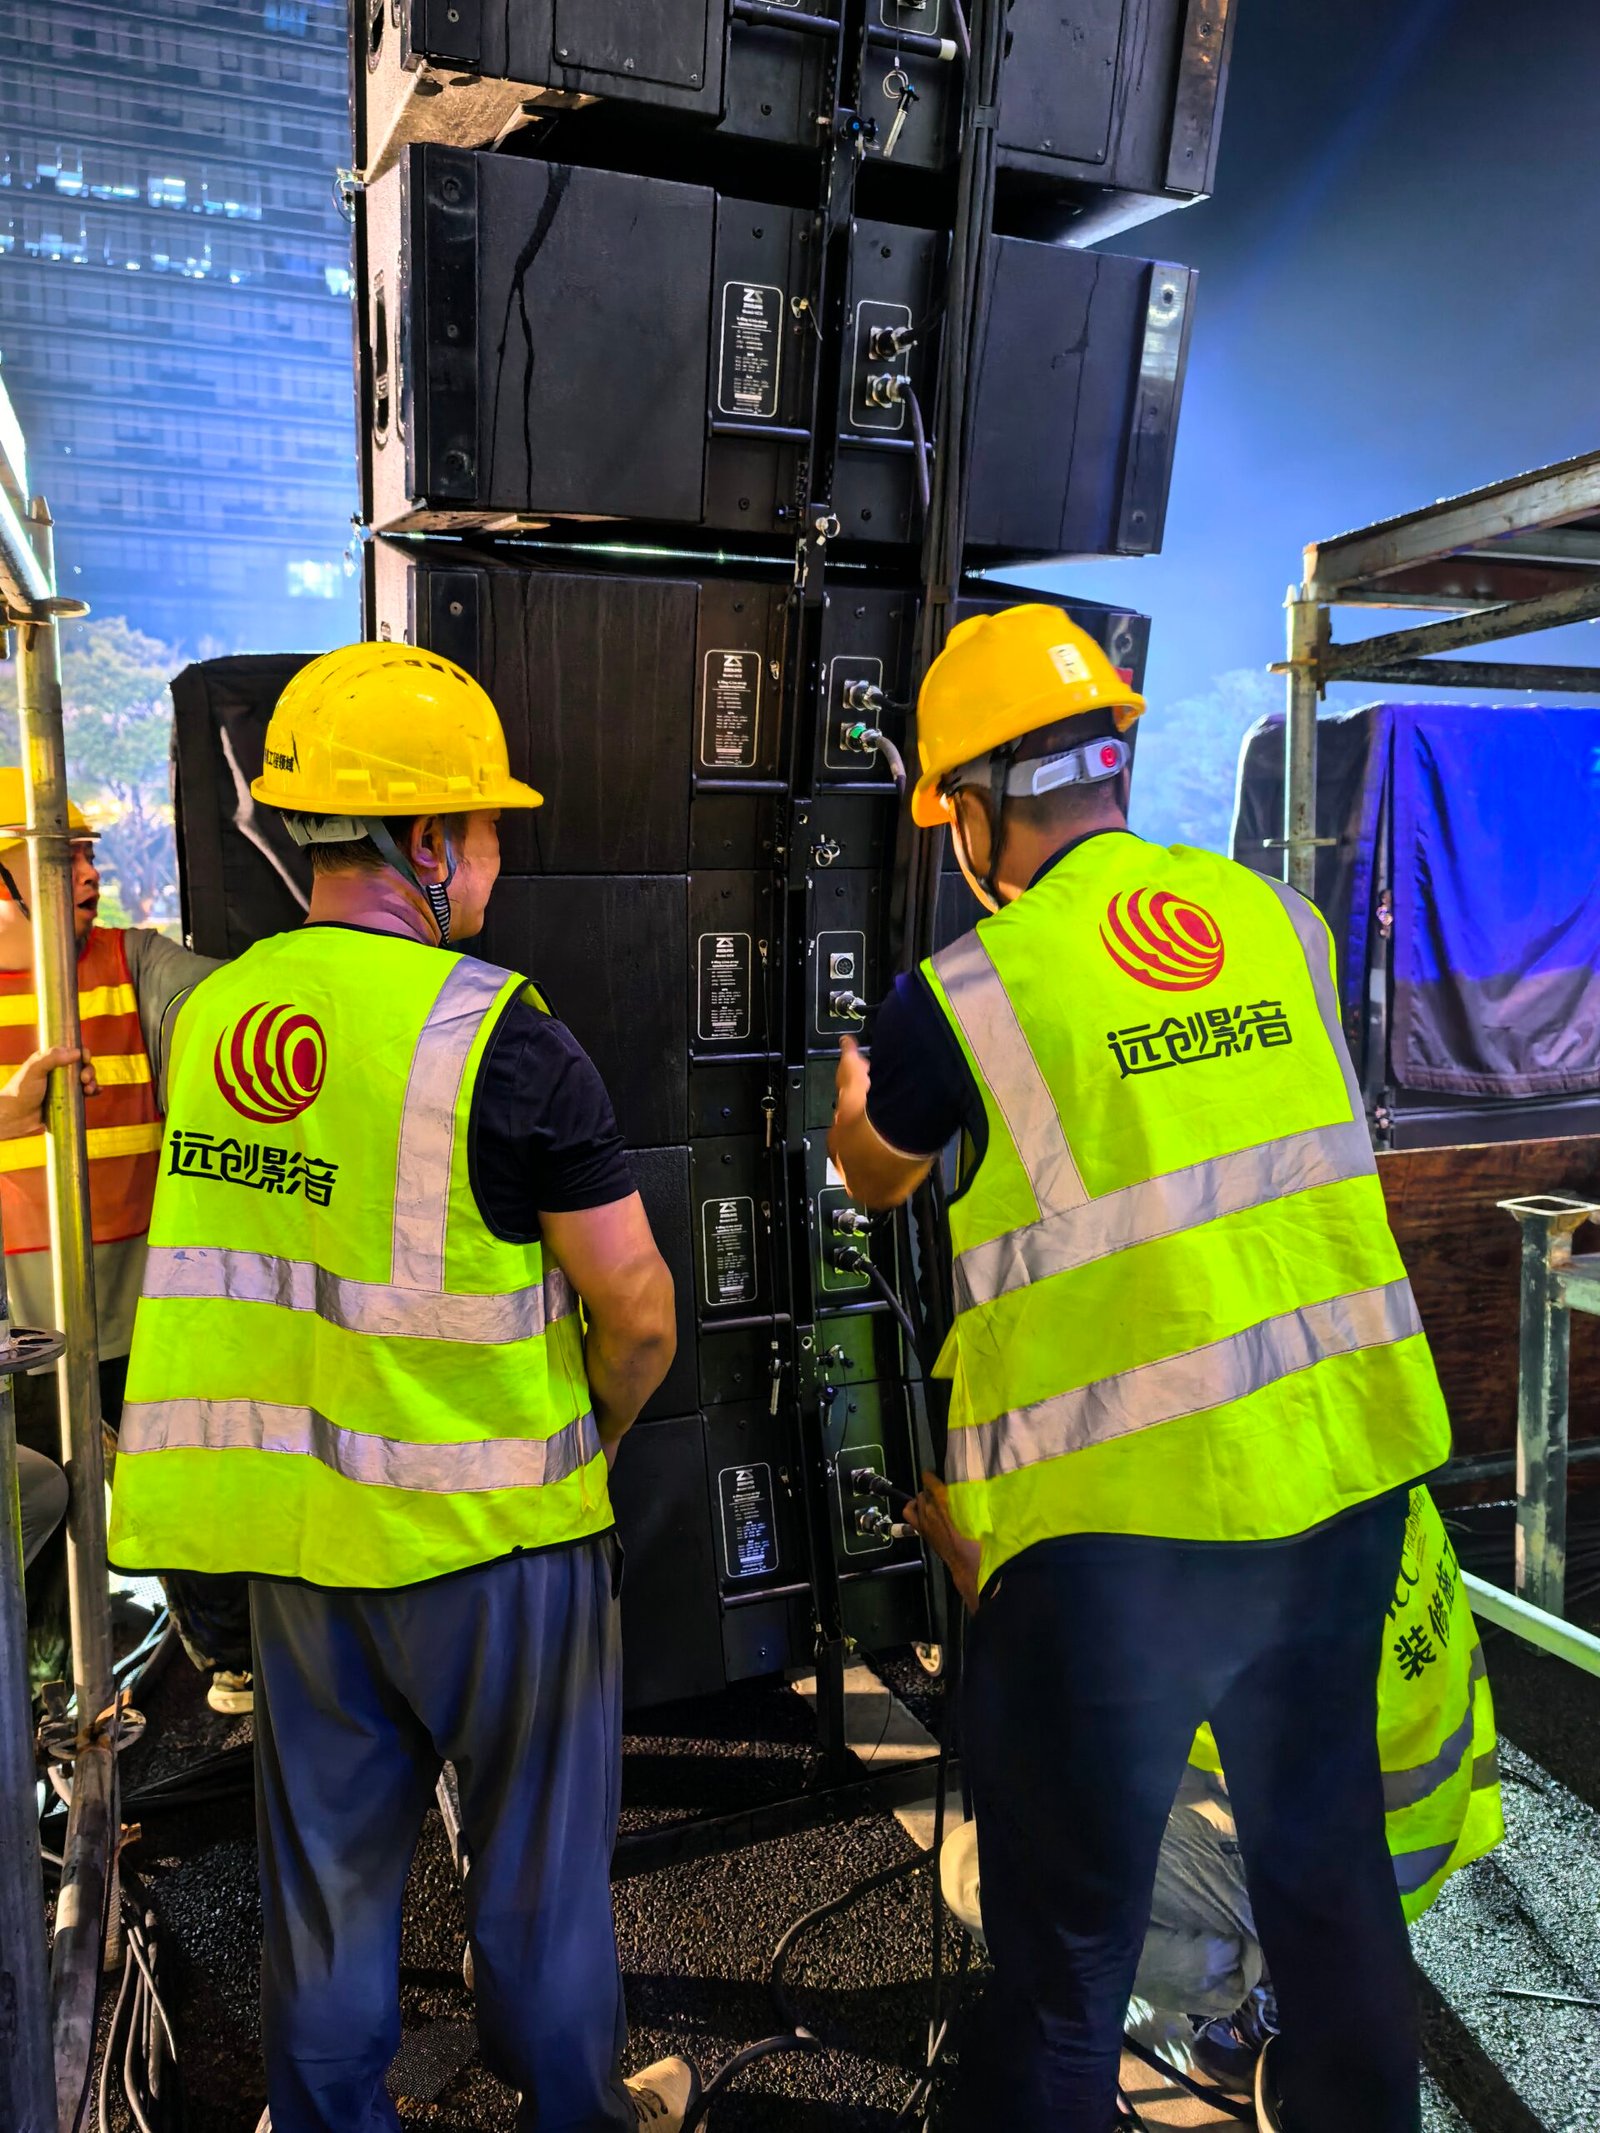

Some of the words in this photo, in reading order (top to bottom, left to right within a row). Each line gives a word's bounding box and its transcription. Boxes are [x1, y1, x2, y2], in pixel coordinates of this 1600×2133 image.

[1107, 1000, 1292, 1080] 远创影音
[167, 1129, 339, 1207] 远创影音
